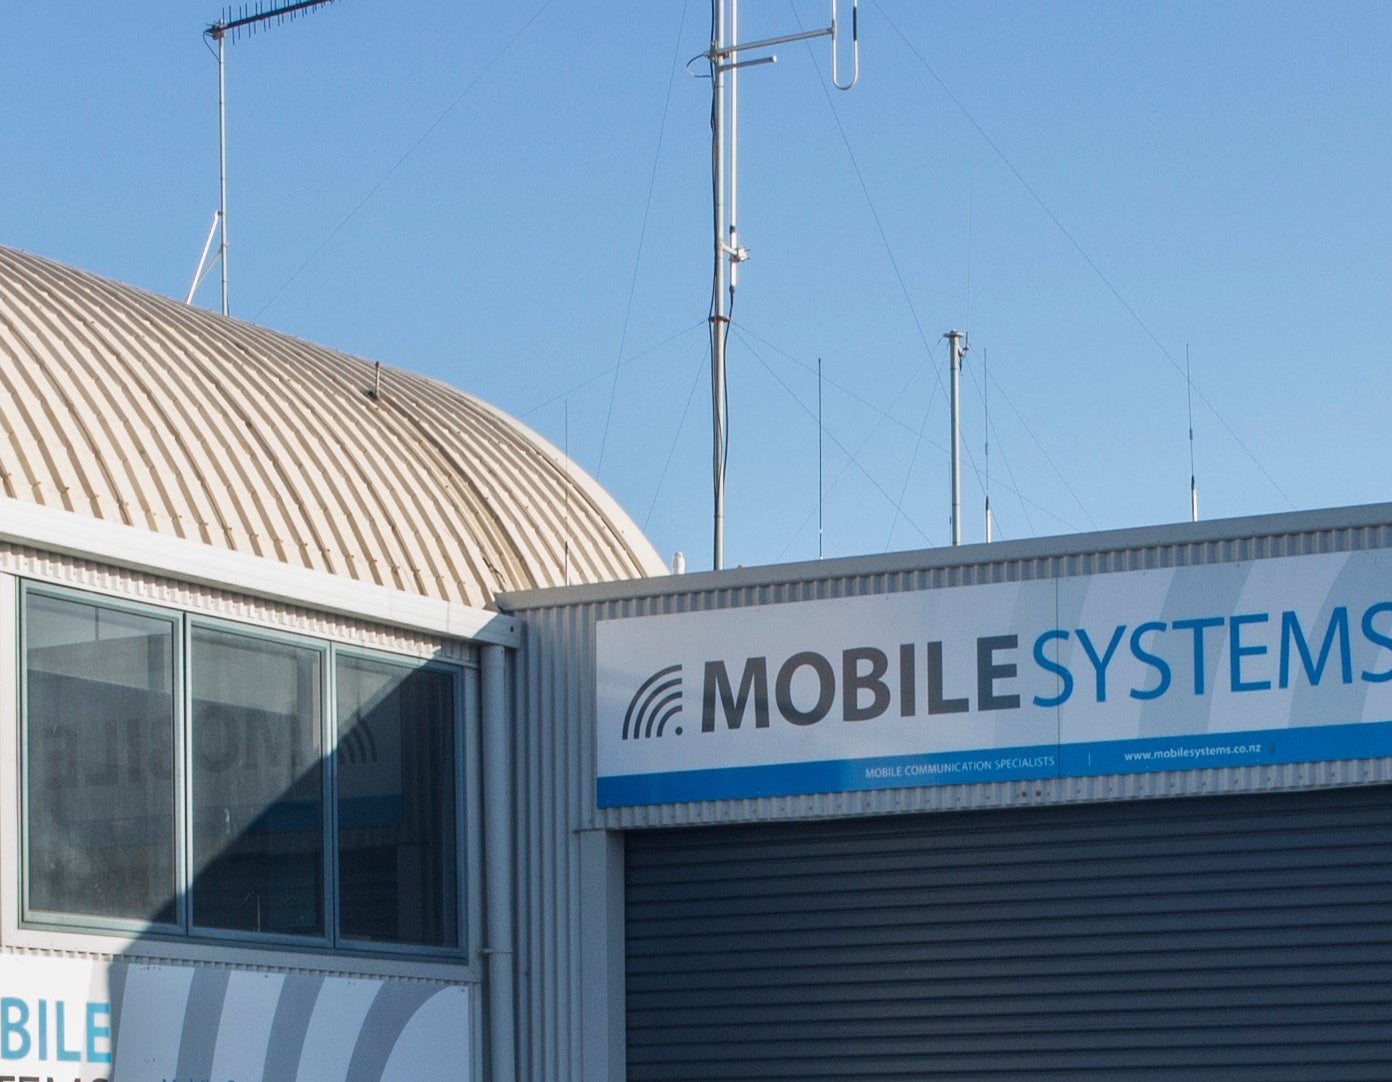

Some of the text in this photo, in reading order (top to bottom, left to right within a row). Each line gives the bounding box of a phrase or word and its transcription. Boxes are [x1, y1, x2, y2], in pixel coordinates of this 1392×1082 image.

[701, 633, 1022, 734] MOBILE
[1124, 744, 1262, 762] www.mobilesystems.co.nz
[865, 755, 1055, 778] MOBILE COMMUNICATION SPECIALISTS
